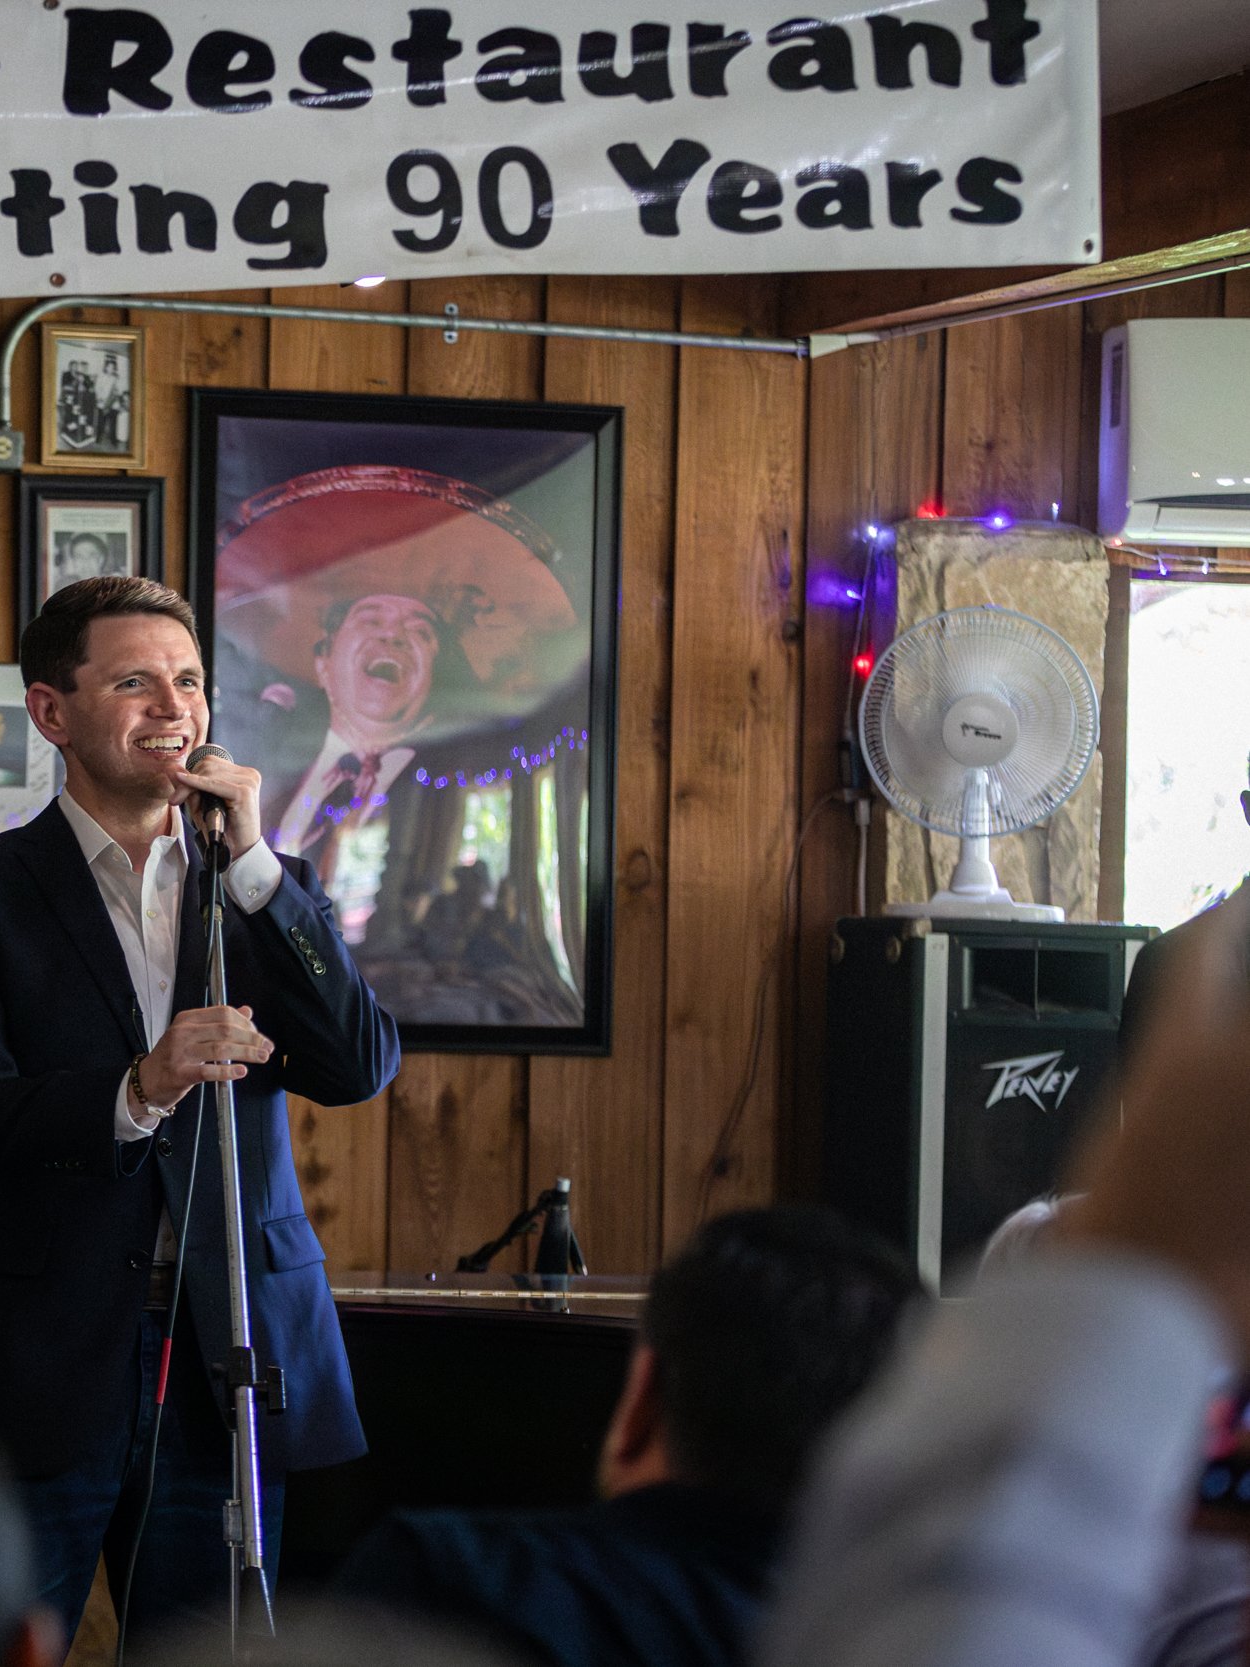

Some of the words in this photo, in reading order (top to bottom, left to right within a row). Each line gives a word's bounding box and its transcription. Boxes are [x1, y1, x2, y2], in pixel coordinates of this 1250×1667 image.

[62, 0, 1042, 117] Restaurant
[384, 146, 554, 254] 90
[606, 138, 1024, 238] Years
